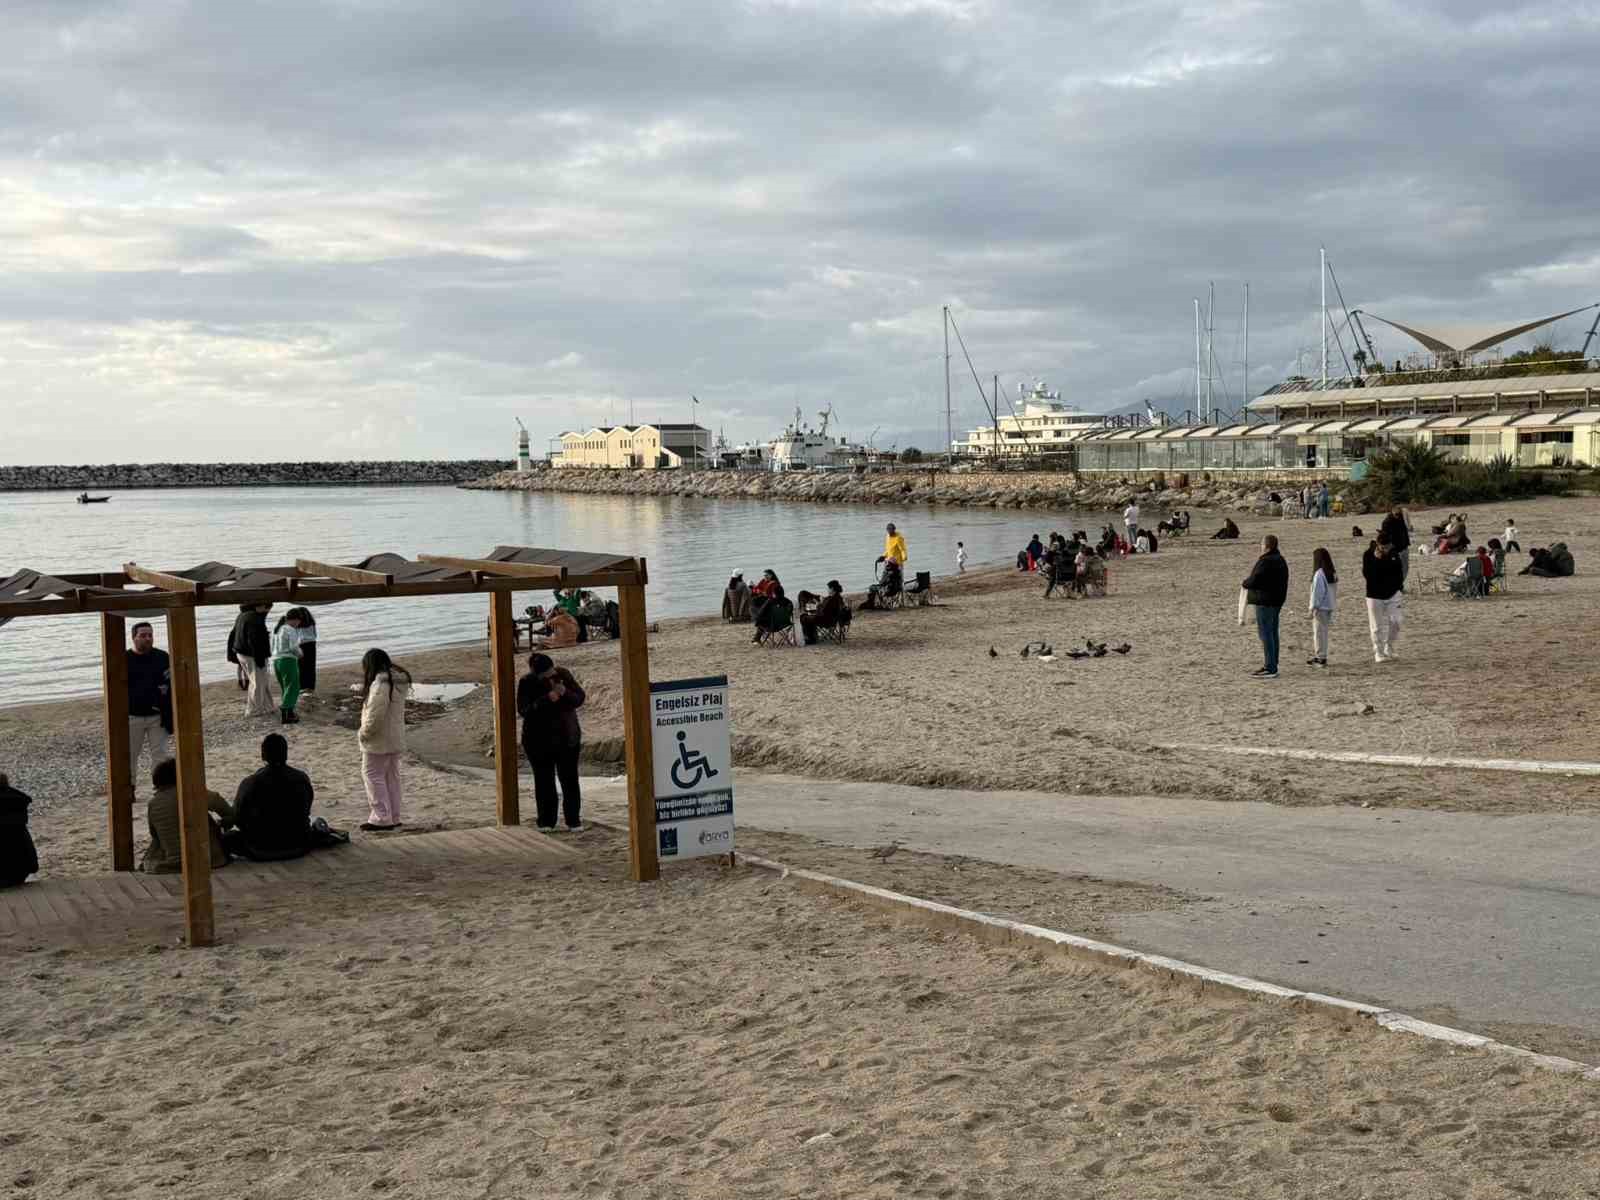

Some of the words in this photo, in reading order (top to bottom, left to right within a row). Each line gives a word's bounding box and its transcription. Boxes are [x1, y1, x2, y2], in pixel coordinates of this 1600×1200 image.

[655, 695, 700, 711] Engelsiz
[702, 692, 723, 705] Plaj
[656, 712, 698, 726] Accessible
[700, 711, 724, 722] Beach
